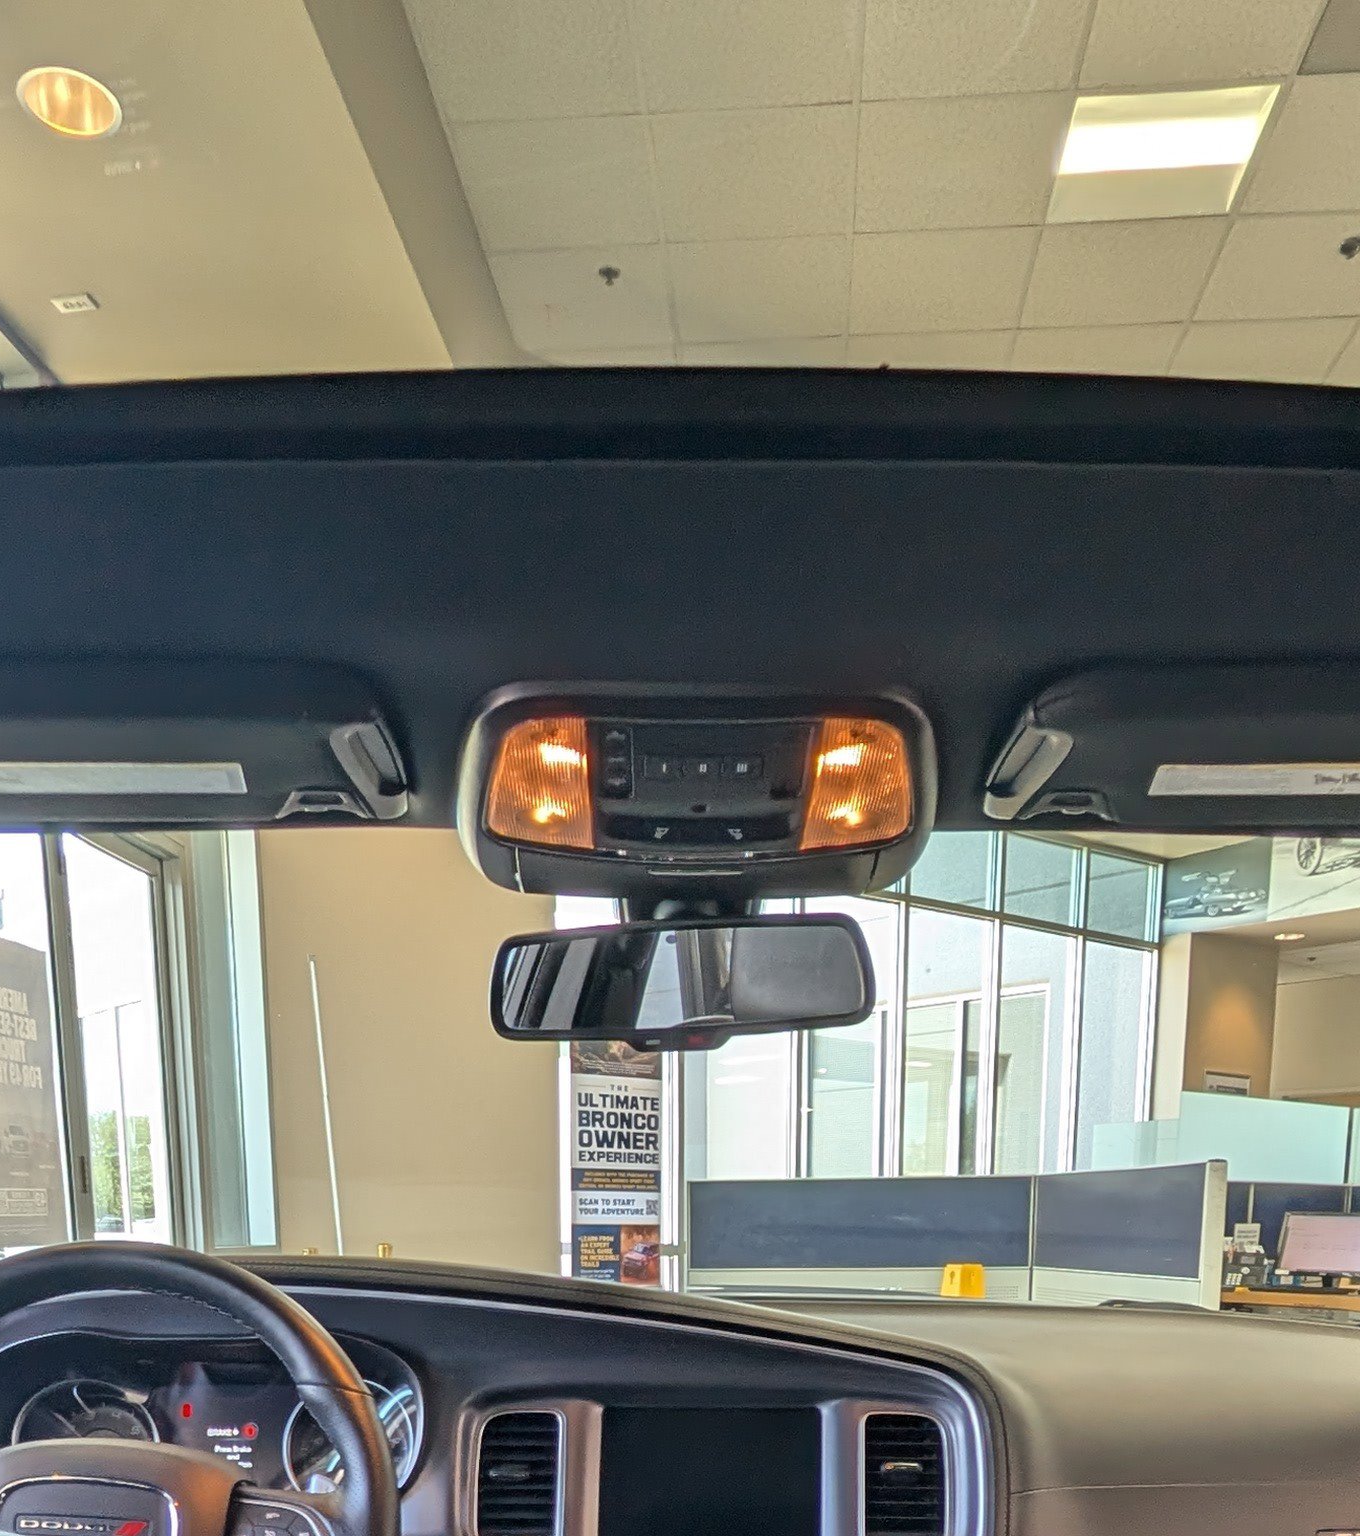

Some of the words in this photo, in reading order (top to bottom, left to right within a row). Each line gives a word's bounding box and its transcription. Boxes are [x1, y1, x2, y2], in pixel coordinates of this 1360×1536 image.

[609, 1084, 629, 1092] THE
[577, 1092, 660, 1112] ULTIMATE
[577, 1110, 660, 1131] BRONCO
[577, 1129, 660, 1151] OWNER
[577, 1150, 660, 1165] EXPERIENCE
[578, 1198, 599, 1206] SCAN
[600, 1198, 611, 1206] TO
[612, 1198, 636, 1206] START
[578, 1207, 599, 1216] YOUR
[601, 1208, 645, 1216] ADVENTURE
